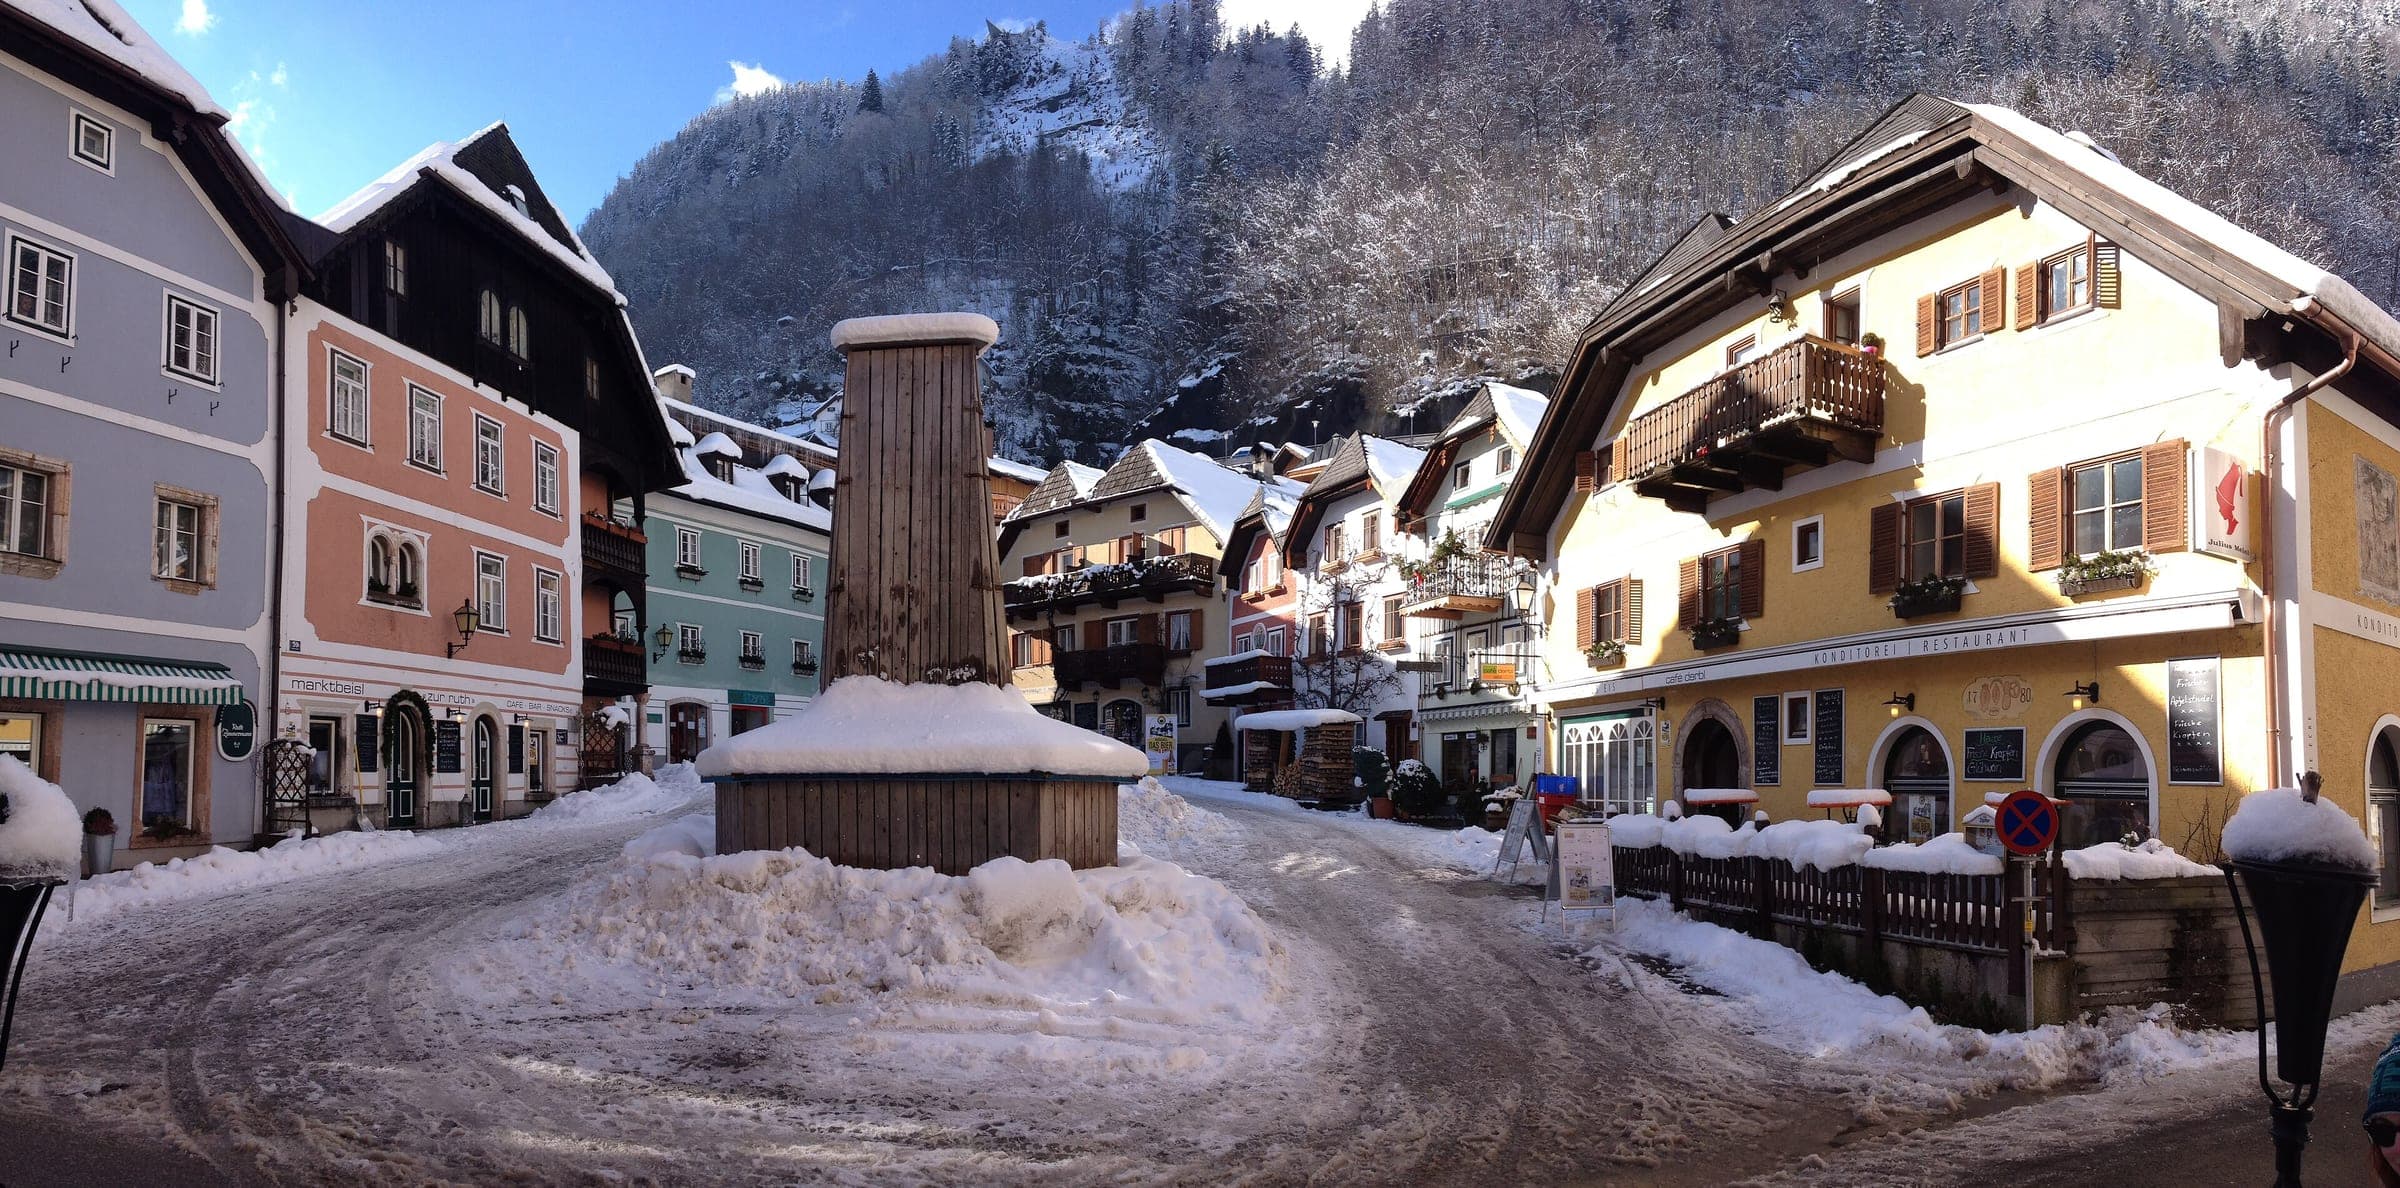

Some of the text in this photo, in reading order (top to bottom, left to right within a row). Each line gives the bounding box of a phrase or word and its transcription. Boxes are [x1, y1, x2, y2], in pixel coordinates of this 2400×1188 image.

[2208, 538, 2232, 550] Julius
[1814, 628, 2028, 665] KONDITOREI RESTAURANT
[1665, 672, 1683, 684] café
[291, 678, 365, 696] marktbeisl
[1967, 687, 2032, 704] 17 80
[528, 702, 542, 710] BAR
